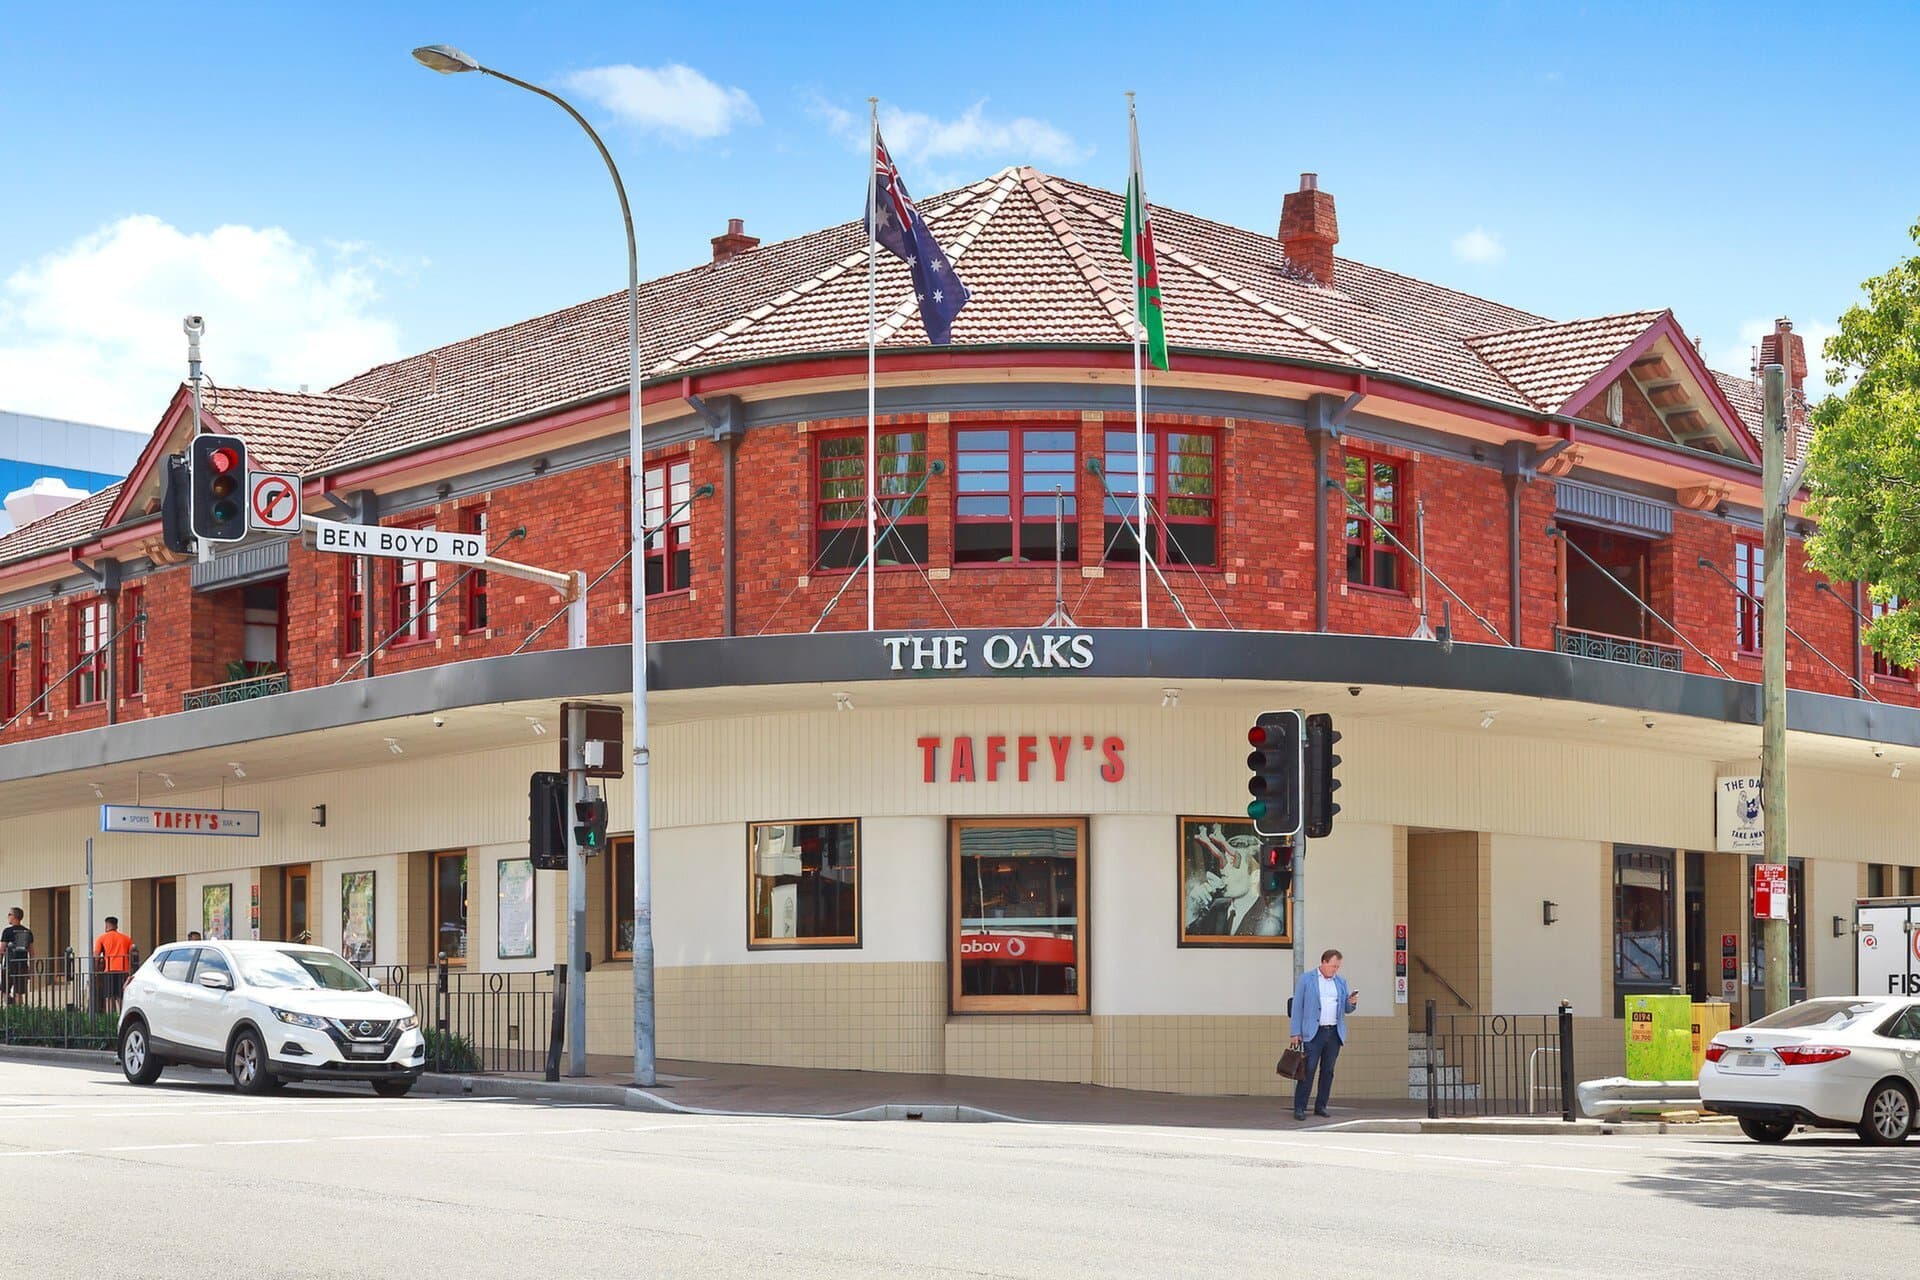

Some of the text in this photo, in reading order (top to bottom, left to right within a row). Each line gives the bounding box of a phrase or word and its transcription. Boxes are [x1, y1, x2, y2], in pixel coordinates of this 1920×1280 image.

[323, 528, 479, 557] BEN BOYD RD
[883, 634, 1095, 670] THE OAKS
[917, 735, 1126, 783] TAFFY'S
[1724, 778, 1765, 792] THE OA
[129, 815, 150, 824] SPORTS
[153, 811, 219, 830] TAFFY'S
[1731, 829, 1747, 840] TAKE
